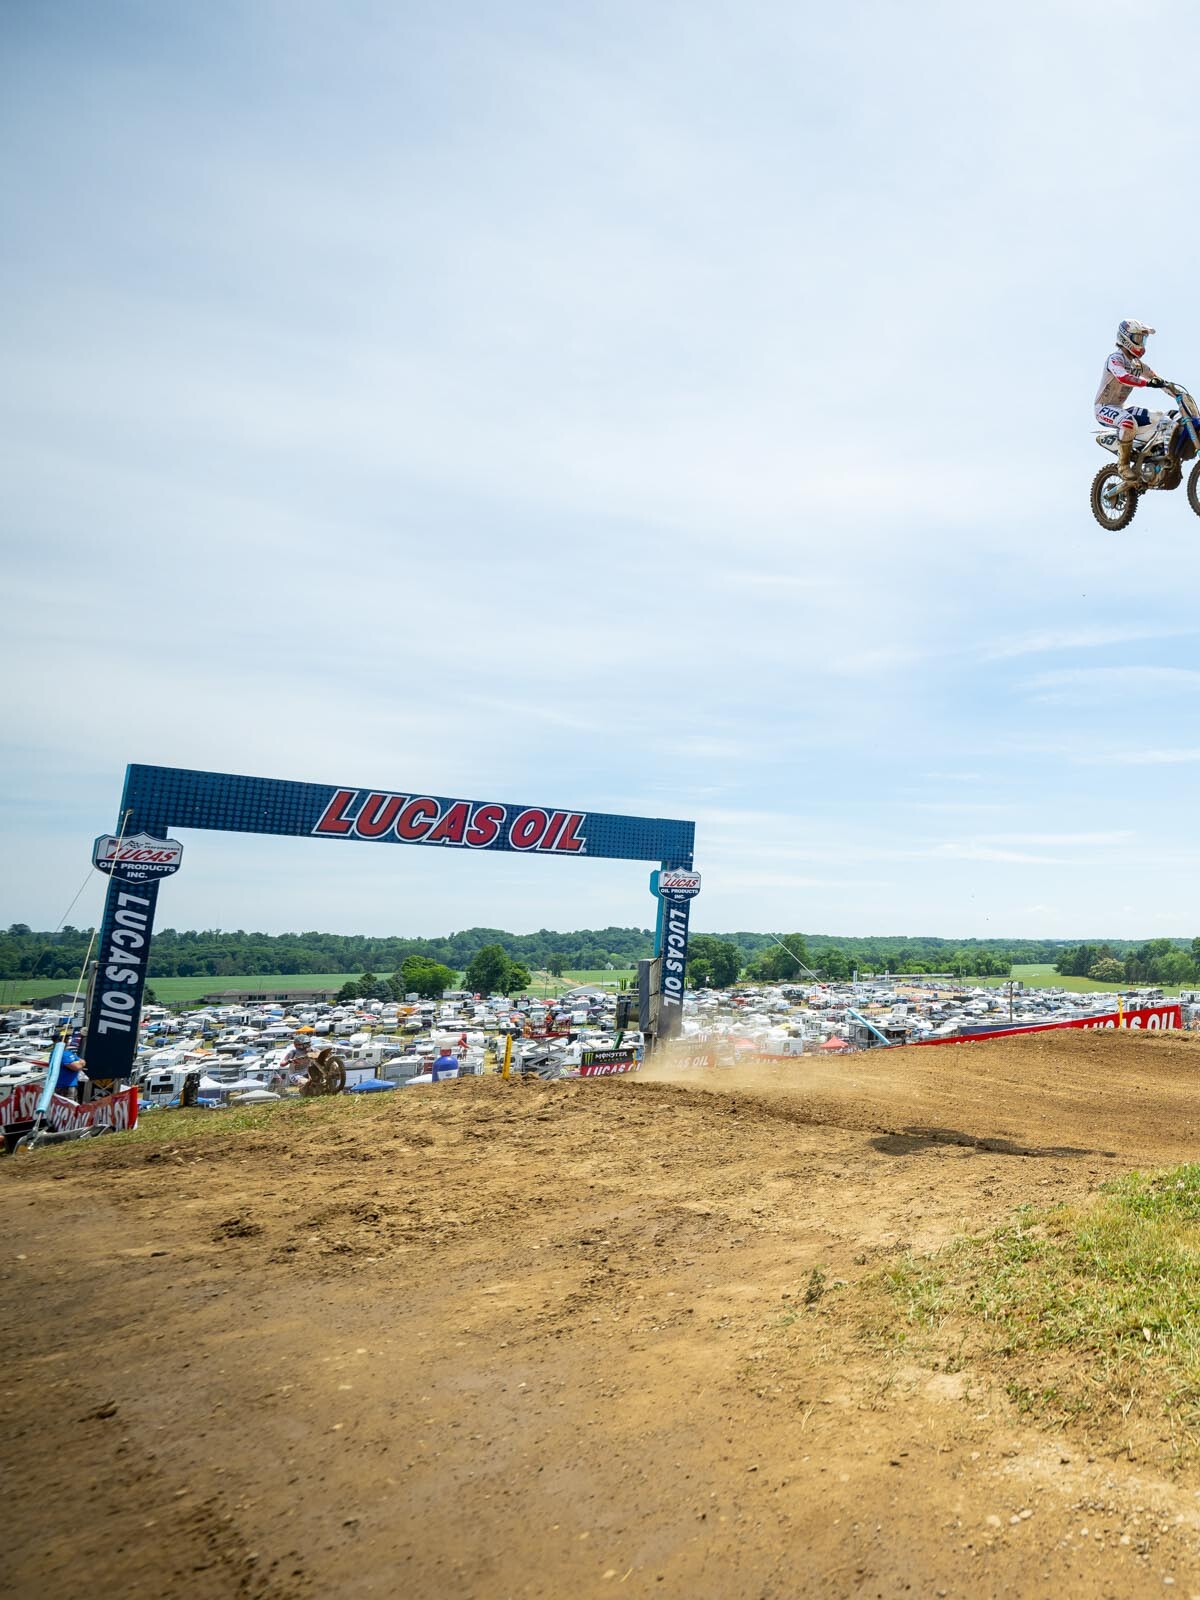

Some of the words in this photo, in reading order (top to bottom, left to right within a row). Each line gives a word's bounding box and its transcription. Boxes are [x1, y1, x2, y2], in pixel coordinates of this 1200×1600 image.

[1099, 406, 1120, 420] FXR
[311, 788, 506, 848] LUCAS
[509, 807, 586, 853] OIL
[105, 847, 178, 862] LUCAS
[99, 861, 118, 869] OIL
[120, 863, 176, 872] PRODUCTS
[664, 879, 699, 887] LUCAS
[105, 891, 150, 985] LUCAS
[666, 908, 687, 973] LUCAS
[664, 976, 682, 1007] OIL
[98, 991, 135, 1034] OIL
[1147, 1011, 1178, 1031] OIL
[595, 1051, 628, 1059] MONSTER
[692, 1055, 709, 1067] OIL
